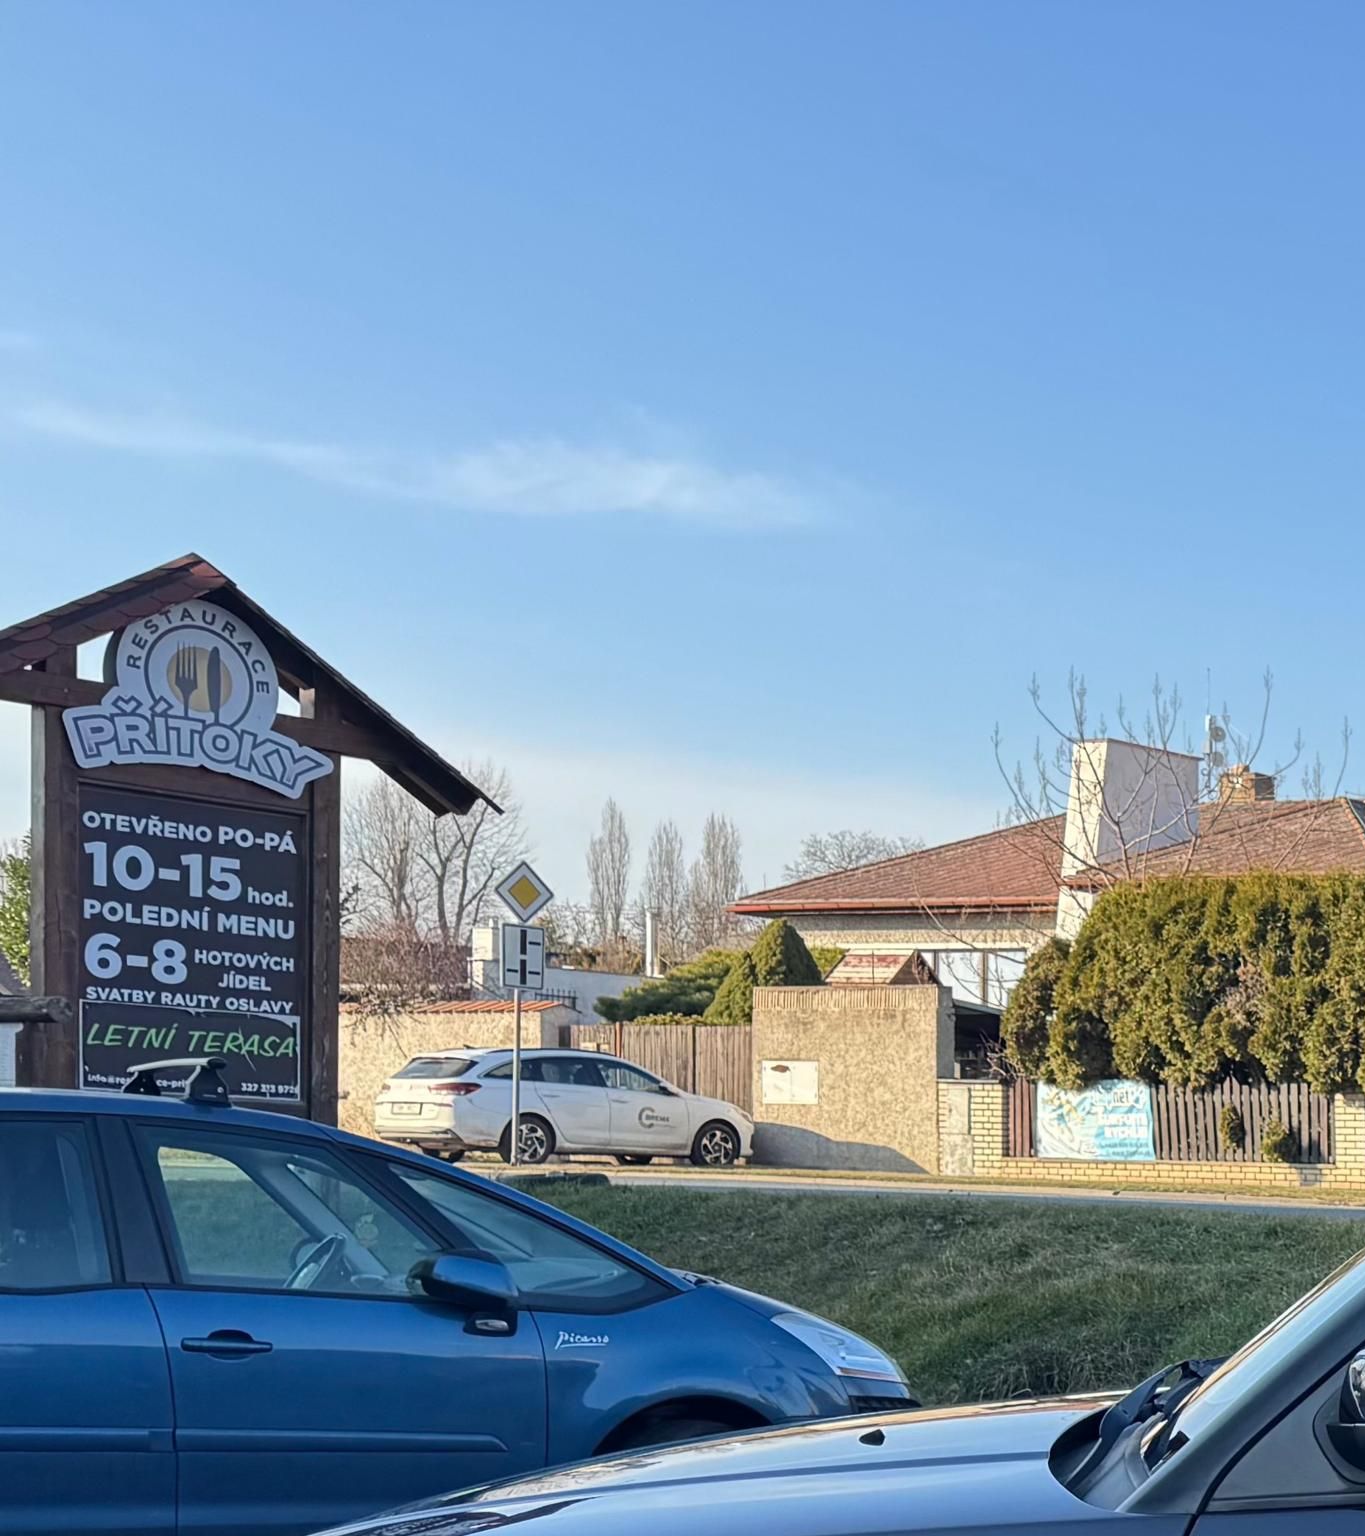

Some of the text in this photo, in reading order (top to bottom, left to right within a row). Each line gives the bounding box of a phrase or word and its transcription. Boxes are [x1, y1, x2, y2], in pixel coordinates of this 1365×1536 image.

[126, 607, 270, 695] RESTAURACE
[72, 696, 326, 790] PŘÍTOKY
[82, 810, 297, 854] OTEVŘENO PO-PÁ
[83, 841, 294, 907] 10-15 hod.
[83, 898, 295, 939] POLEDNÍ MENU
[84, 933, 188, 984] 6-8
[194, 949, 295, 972] HOTOVÝCH
[86, 986, 293, 1014] SVATBY RAUTY OSLAVY
[218, 971, 272, 991] JÍDEL
[86, 1023, 295, 1057] LETNÍ TERASA
[554, 1331, 609, 1350] Picasso
